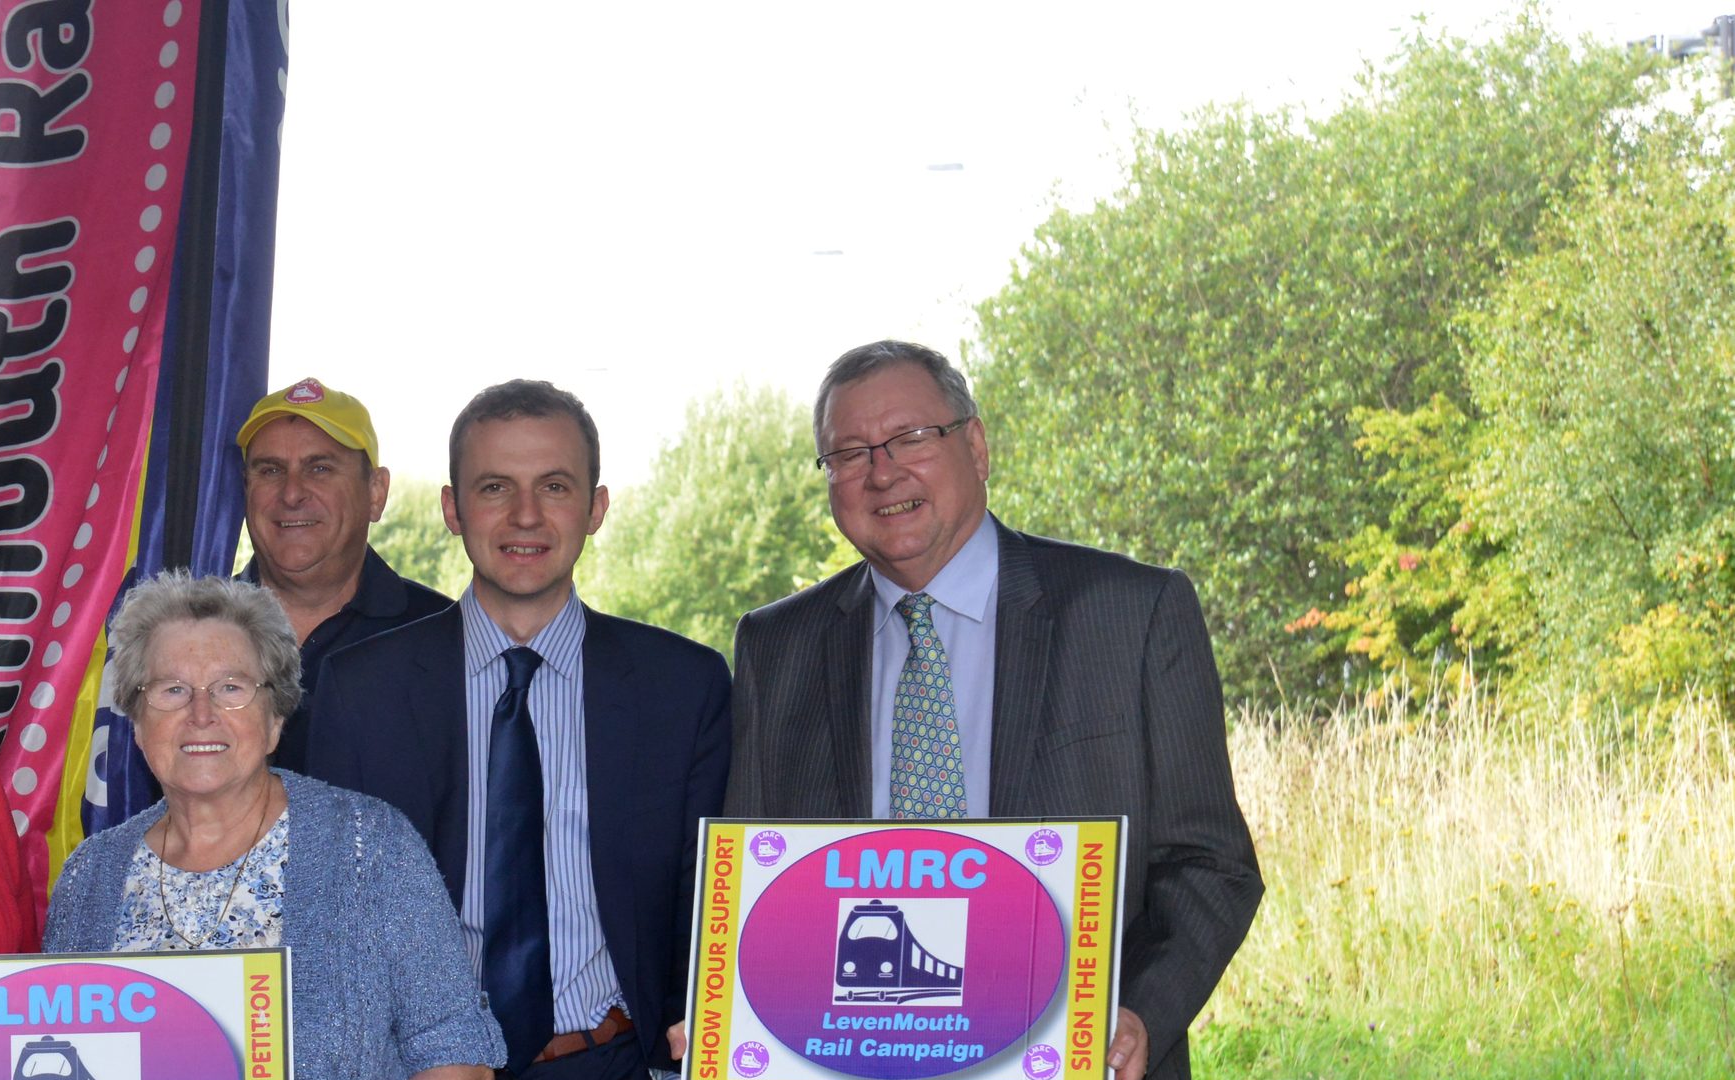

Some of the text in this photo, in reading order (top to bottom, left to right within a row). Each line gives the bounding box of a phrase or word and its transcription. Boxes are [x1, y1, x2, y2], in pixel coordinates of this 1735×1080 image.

[824, 848, 988, 889] LMRC
[699, 835, 734, 1078] SHOW YOUR SUPPORT
[1071, 842, 1103, 1070] SIGN THE PETITION
[250, 974, 272, 1078] PETITION
[805, 1038, 984, 1062] Rail Campaign
[822, 1012, 970, 1031] LevenMouth
